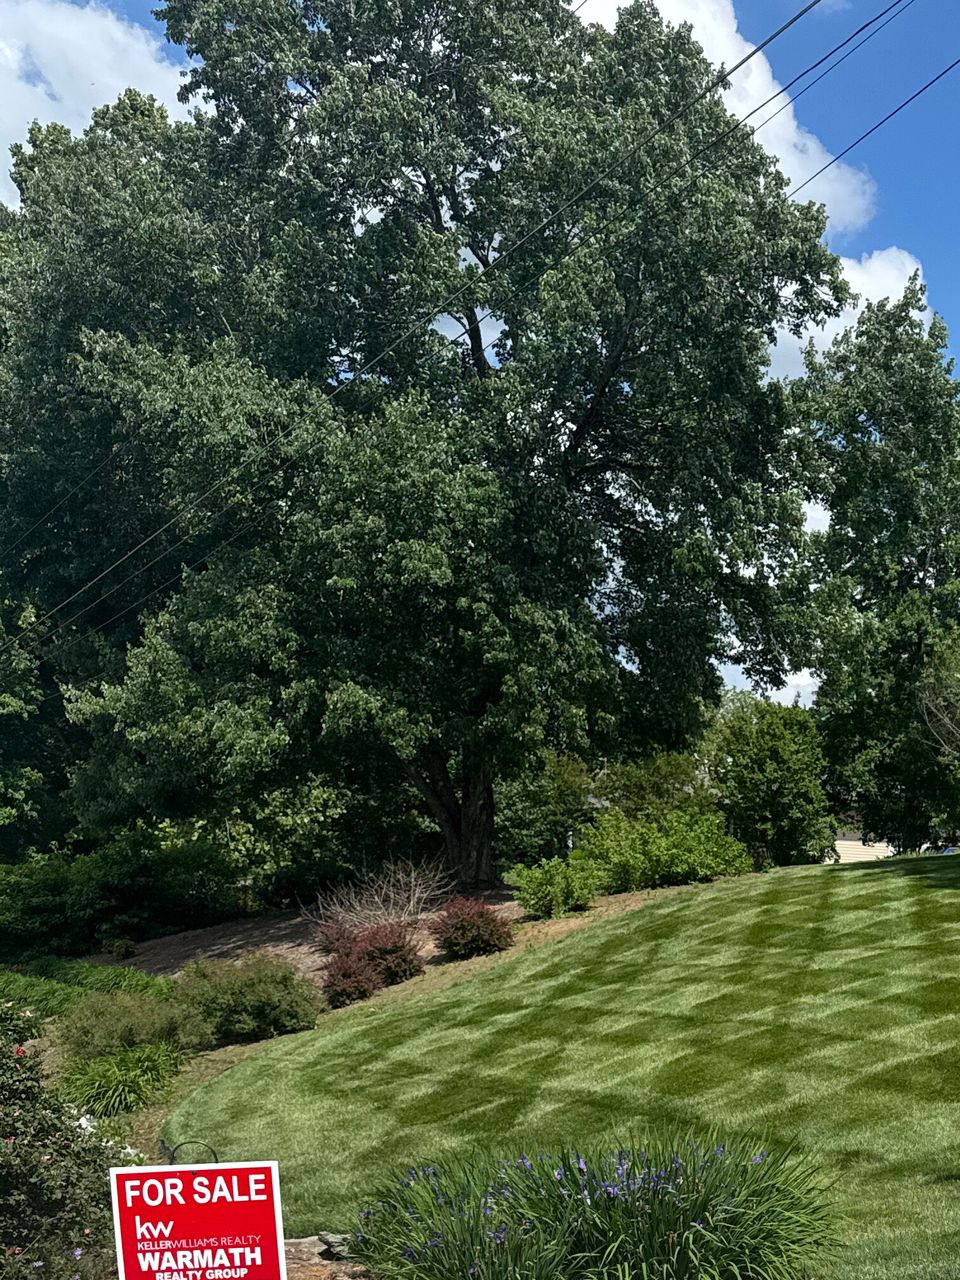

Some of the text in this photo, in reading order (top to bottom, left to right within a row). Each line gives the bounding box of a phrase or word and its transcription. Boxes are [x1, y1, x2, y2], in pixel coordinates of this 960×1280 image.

[125, 1174, 267, 1207] FOR SALE
[135, 1216, 174, 1239] kw
[221, 1235, 261, 1246] REALTY
[137, 1247, 262, 1271] WARMATH
[206, 1268, 248, 1280] GROUP
